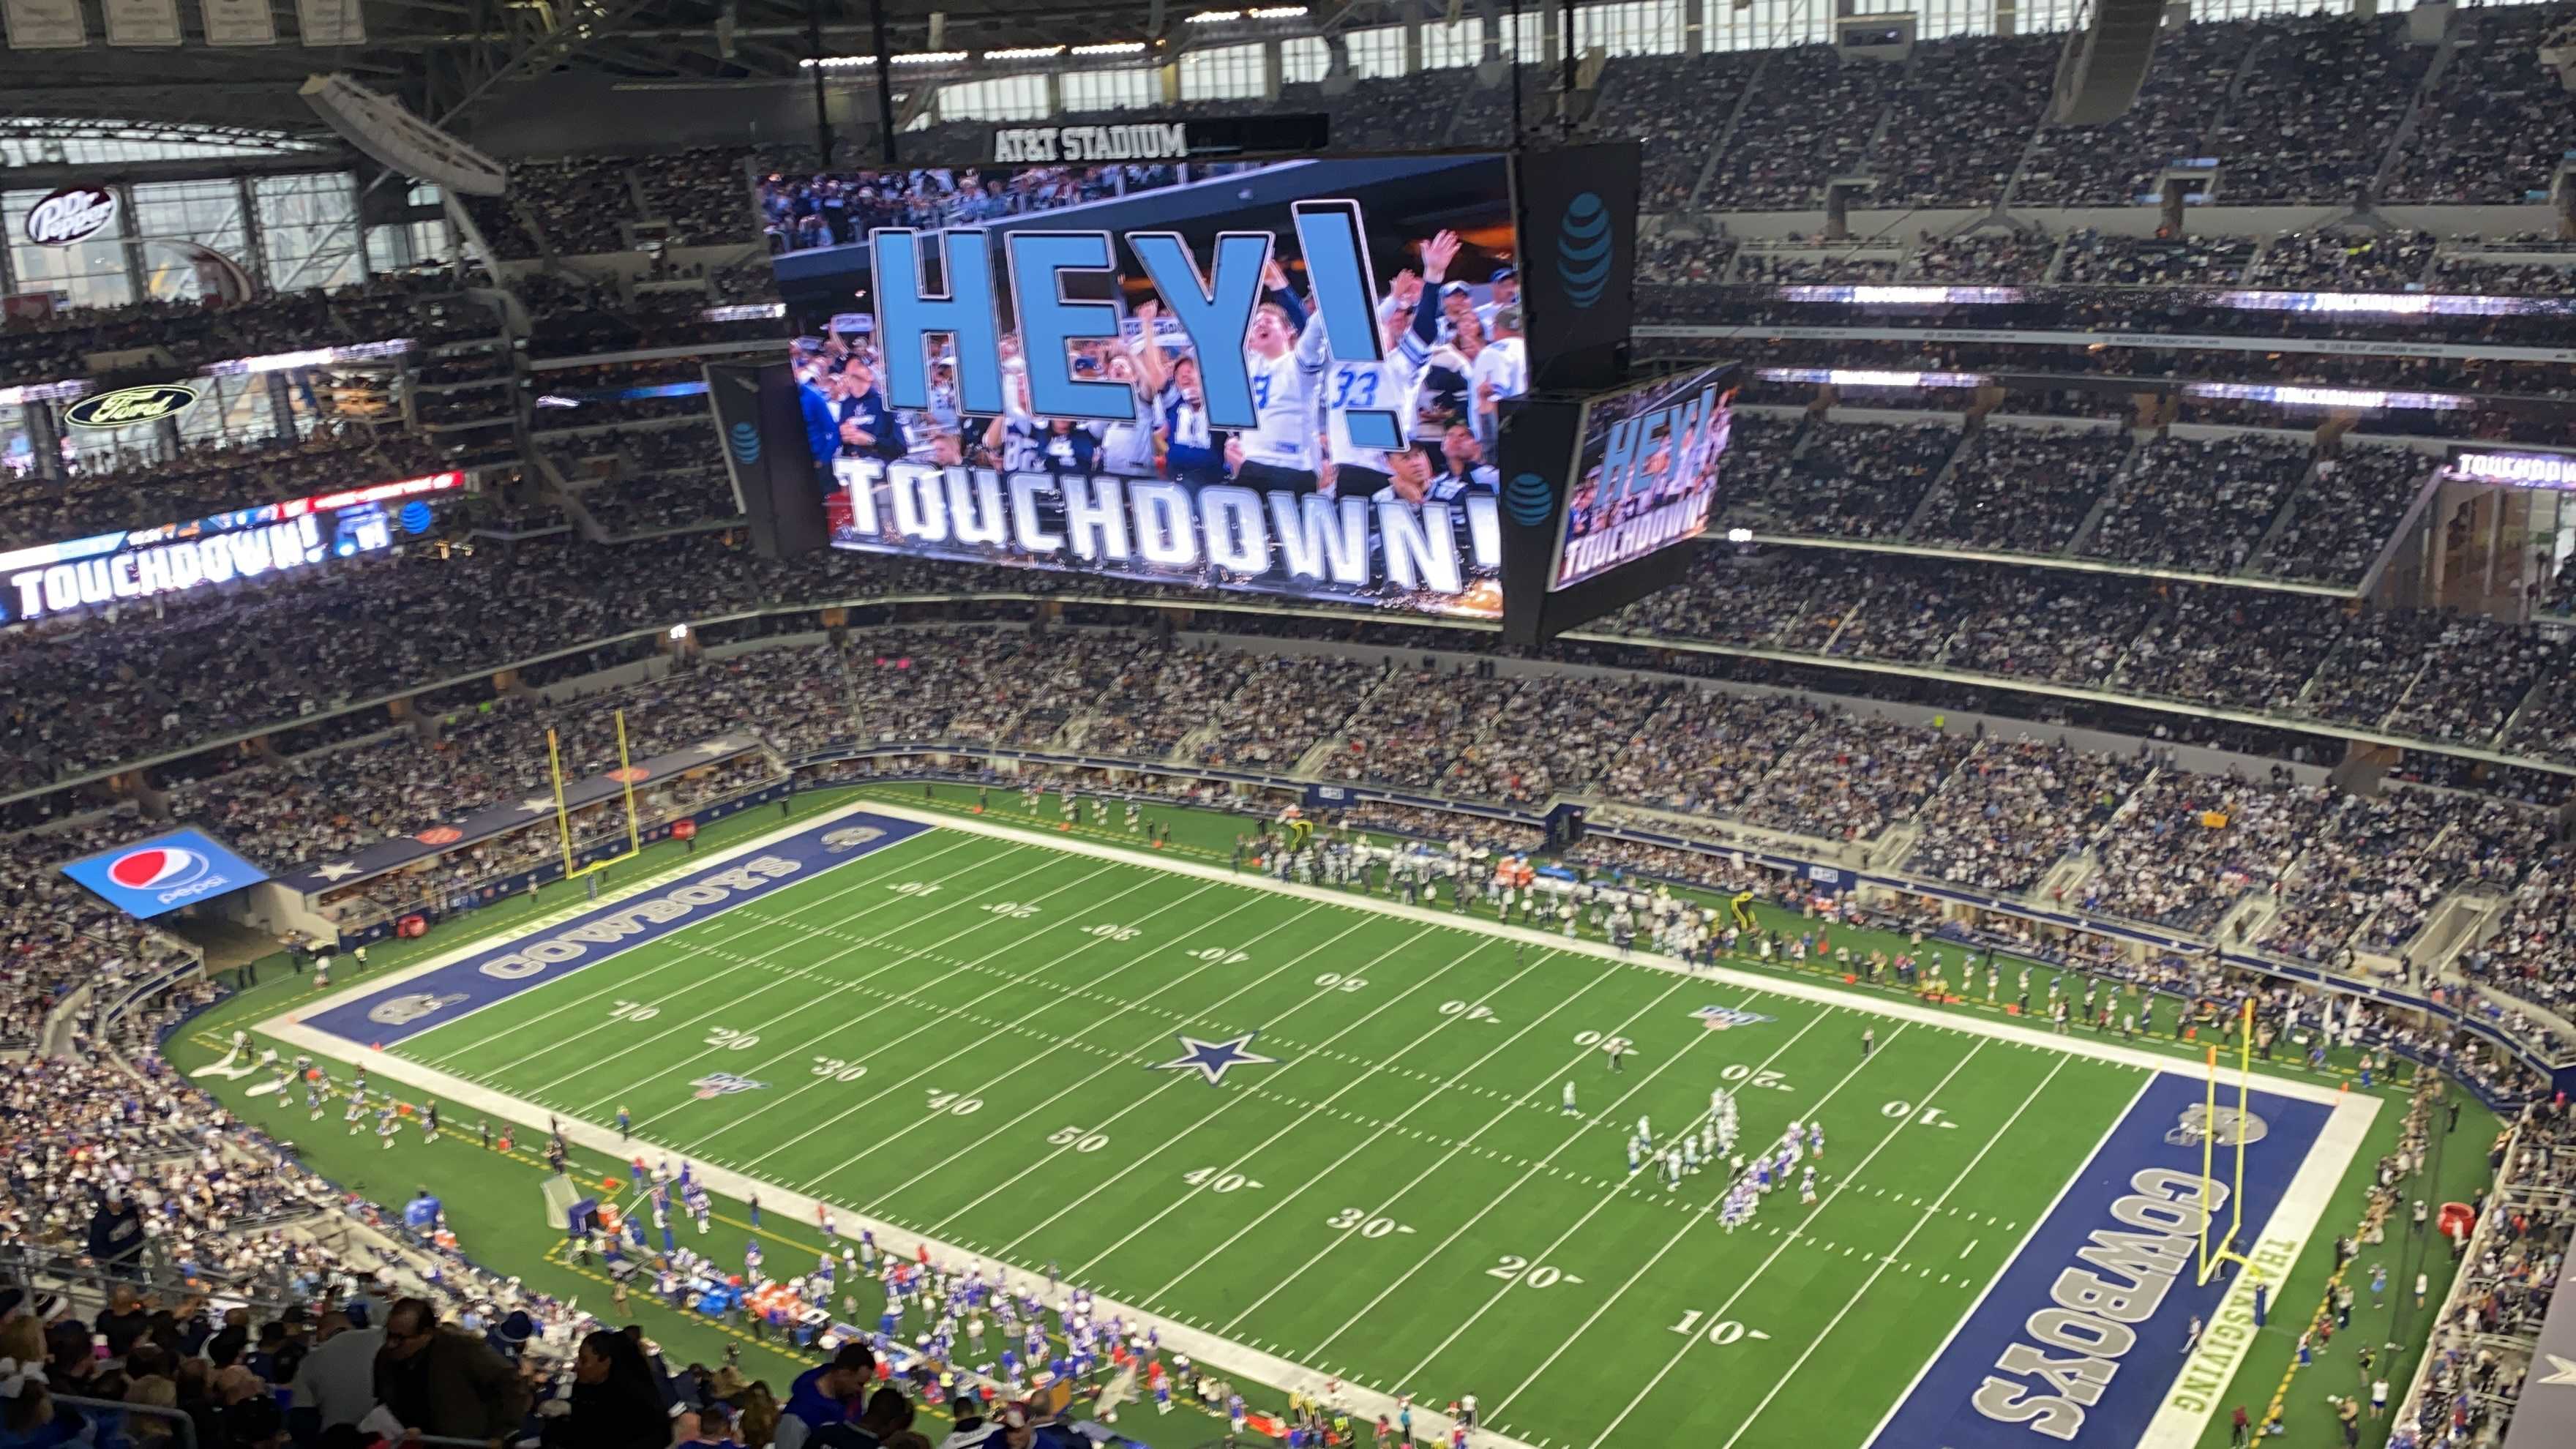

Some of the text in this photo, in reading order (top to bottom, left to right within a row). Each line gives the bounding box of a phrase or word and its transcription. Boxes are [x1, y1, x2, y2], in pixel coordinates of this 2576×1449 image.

[994, 122, 1188, 162] AT&T STADIUM
[63, 190, 100, 212] Dr
[37, 200, 113, 242] Pepper
[869, 199, 1410, 452] HEY!
[89, 389, 176, 423] Ford
[1593, 381, 1718, 509] HEY!
[11, 513, 327, 618] TOUCHDOWN!
[157, 873, 231, 905] pepsi
[479, 855, 802, 980] COWBOYS
[1046, 1125, 1110, 1153] 50
[1182, 1165, 1246, 1194] 40
[1325, 1207, 1396, 1239] 30
[1483, 1254, 1562, 1289] 20
[1972, 1167, 2231, 1441] COWBOYS
[1666, 1308, 1746, 1345] 10
